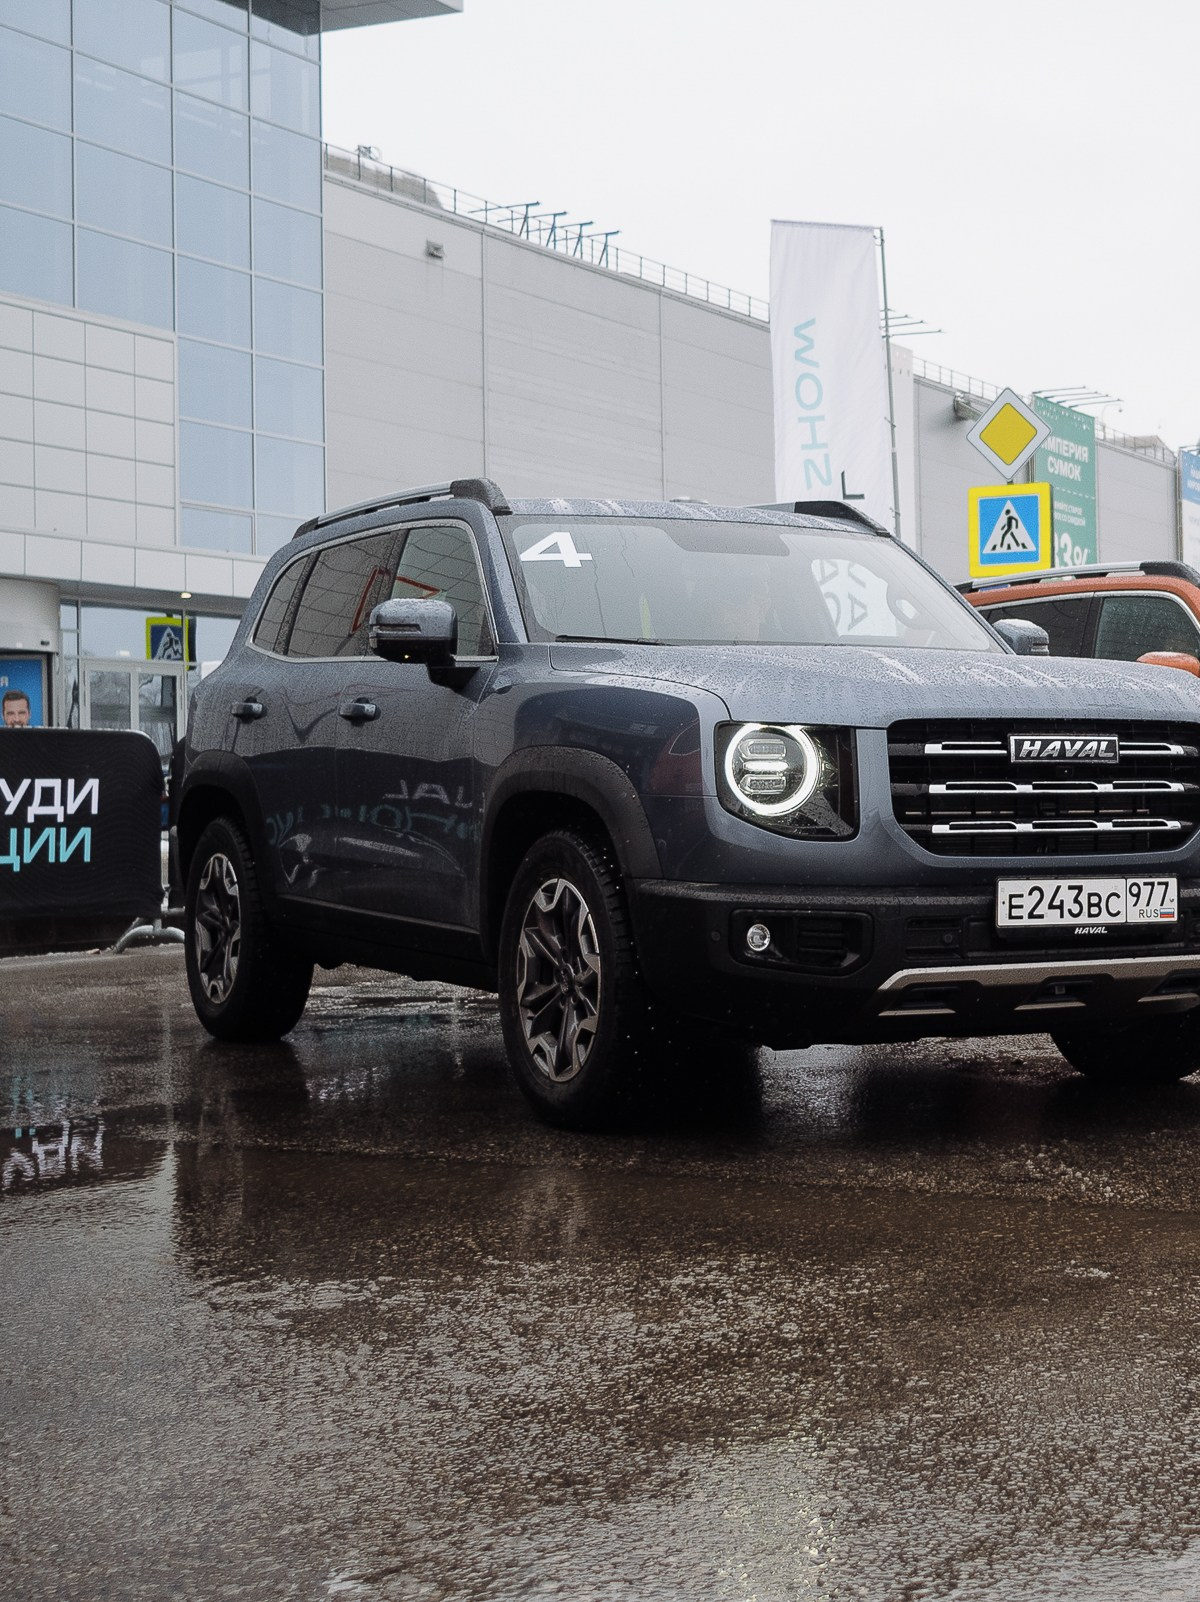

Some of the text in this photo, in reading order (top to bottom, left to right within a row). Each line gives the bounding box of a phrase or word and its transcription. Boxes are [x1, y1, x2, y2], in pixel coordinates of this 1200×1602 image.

[1047, 456, 1081, 482] СУМОК
[520, 531, 592, 568] 4
[1019, 740, 1115, 759] HAVAL
[0, 778, 99, 823] УДИ
[1008, 881, 1169, 919] Е243ВС 977
[1138, 909, 1158, 918] RUS
[1074, 926, 1108, 935] HAVAL
